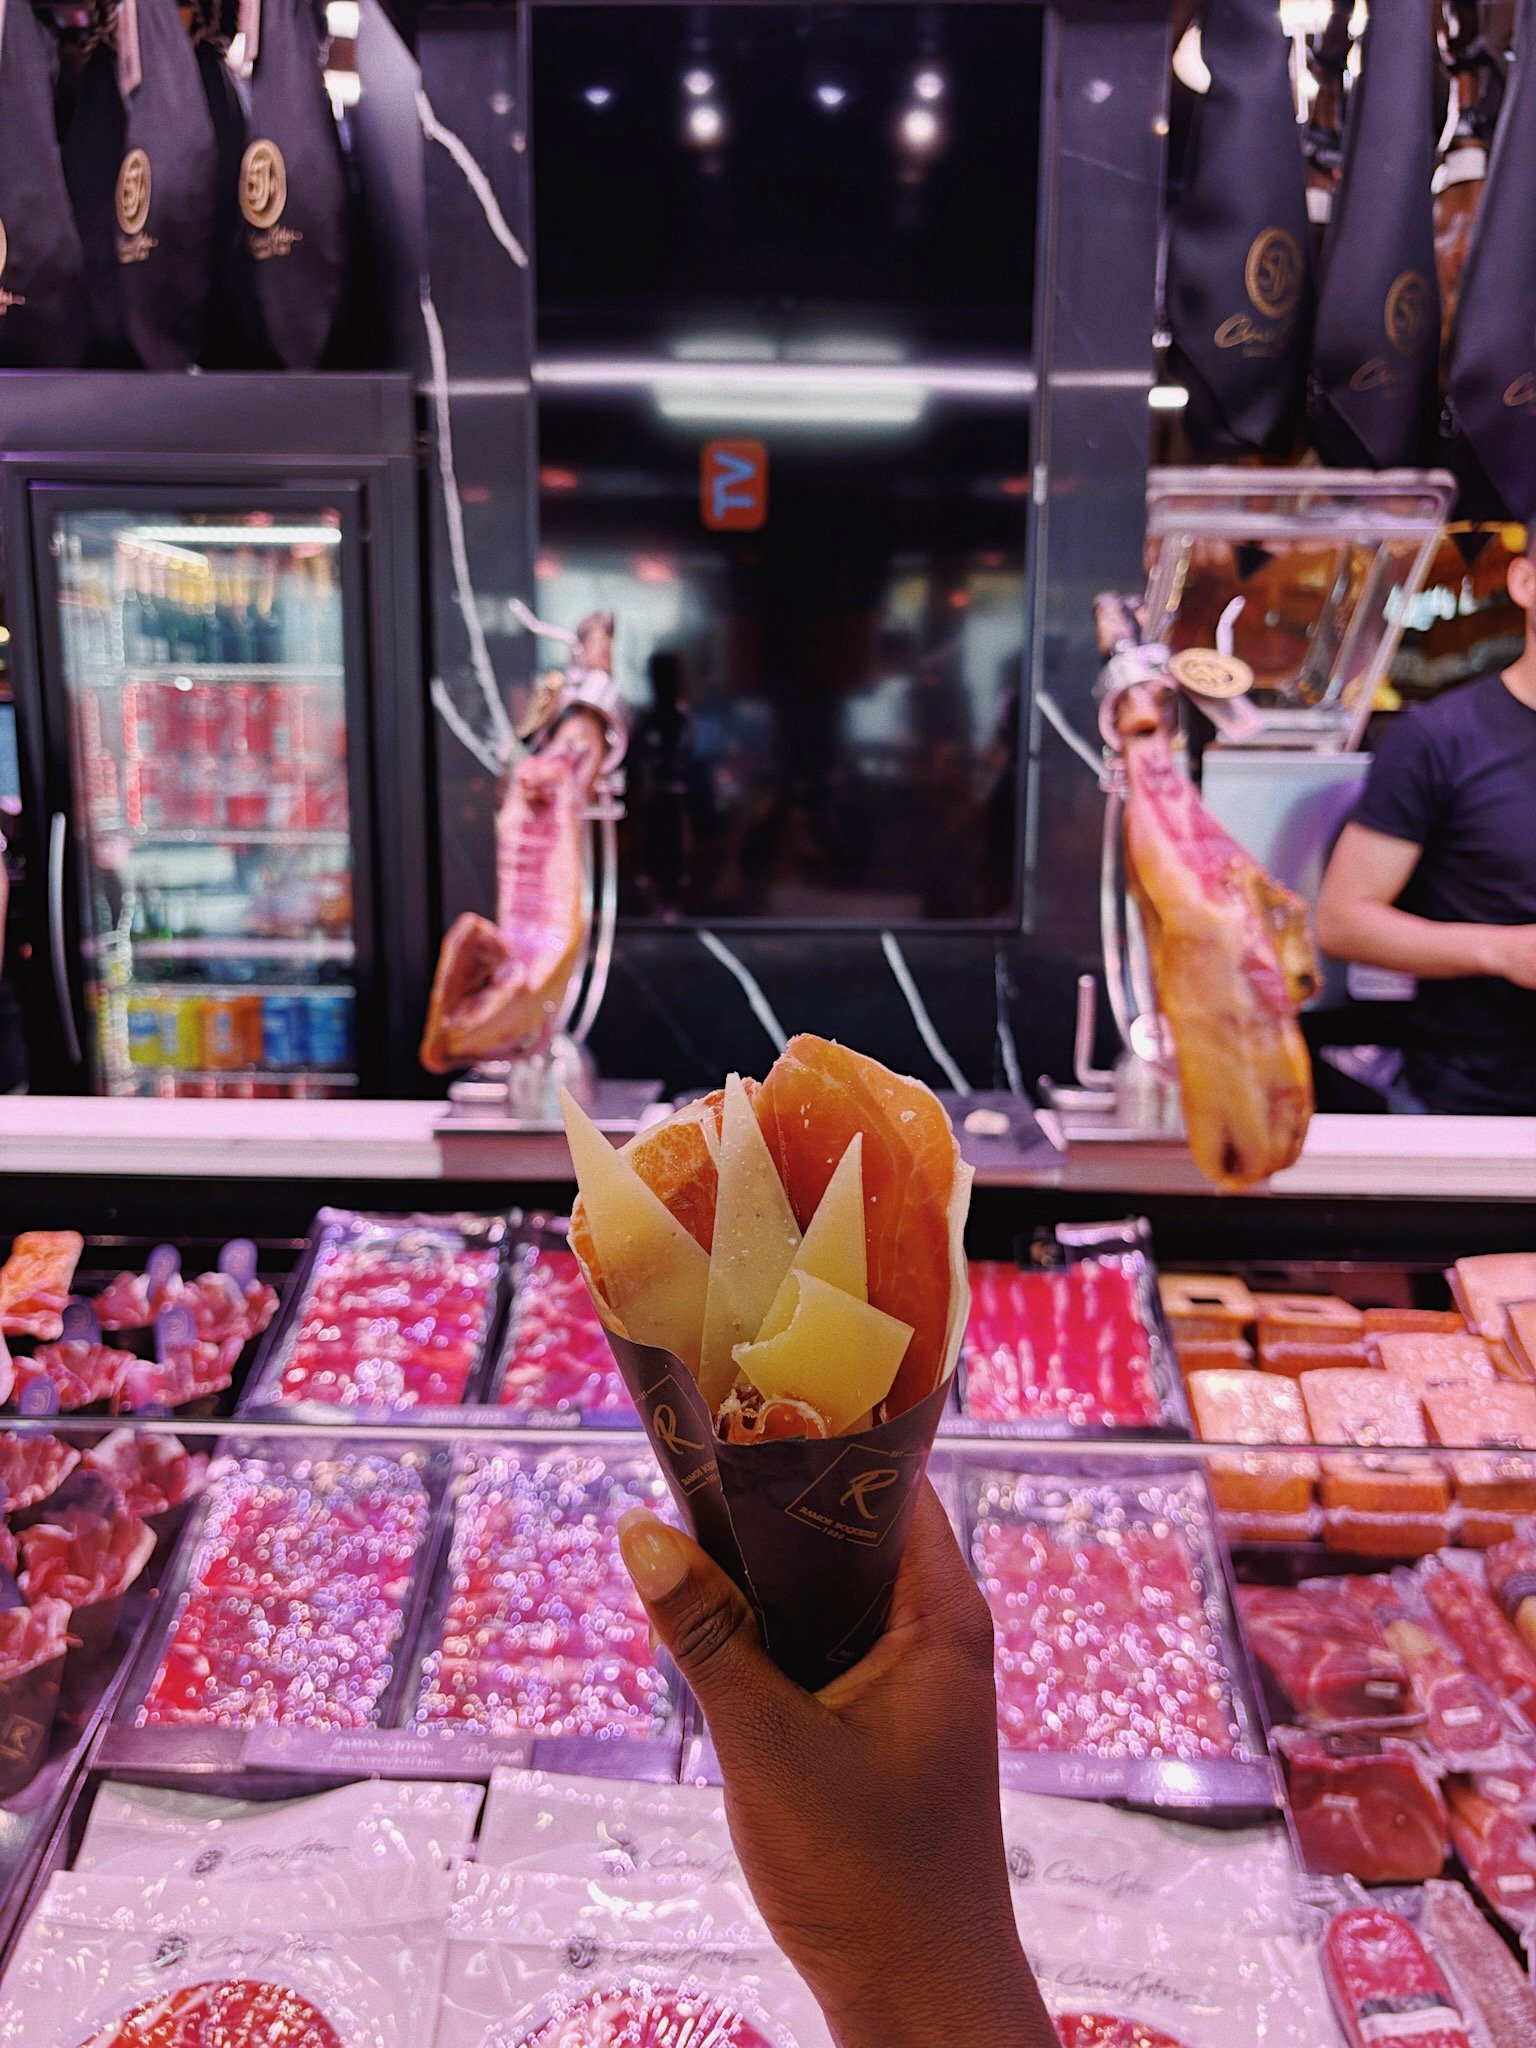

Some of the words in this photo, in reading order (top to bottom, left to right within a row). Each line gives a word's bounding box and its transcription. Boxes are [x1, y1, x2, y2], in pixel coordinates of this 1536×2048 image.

[713, 450, 756, 520] TV
[653, 1404, 705, 1455] R
[799, 1506, 833, 1526] RAMOS
[839, 1468, 898, 1520] R
